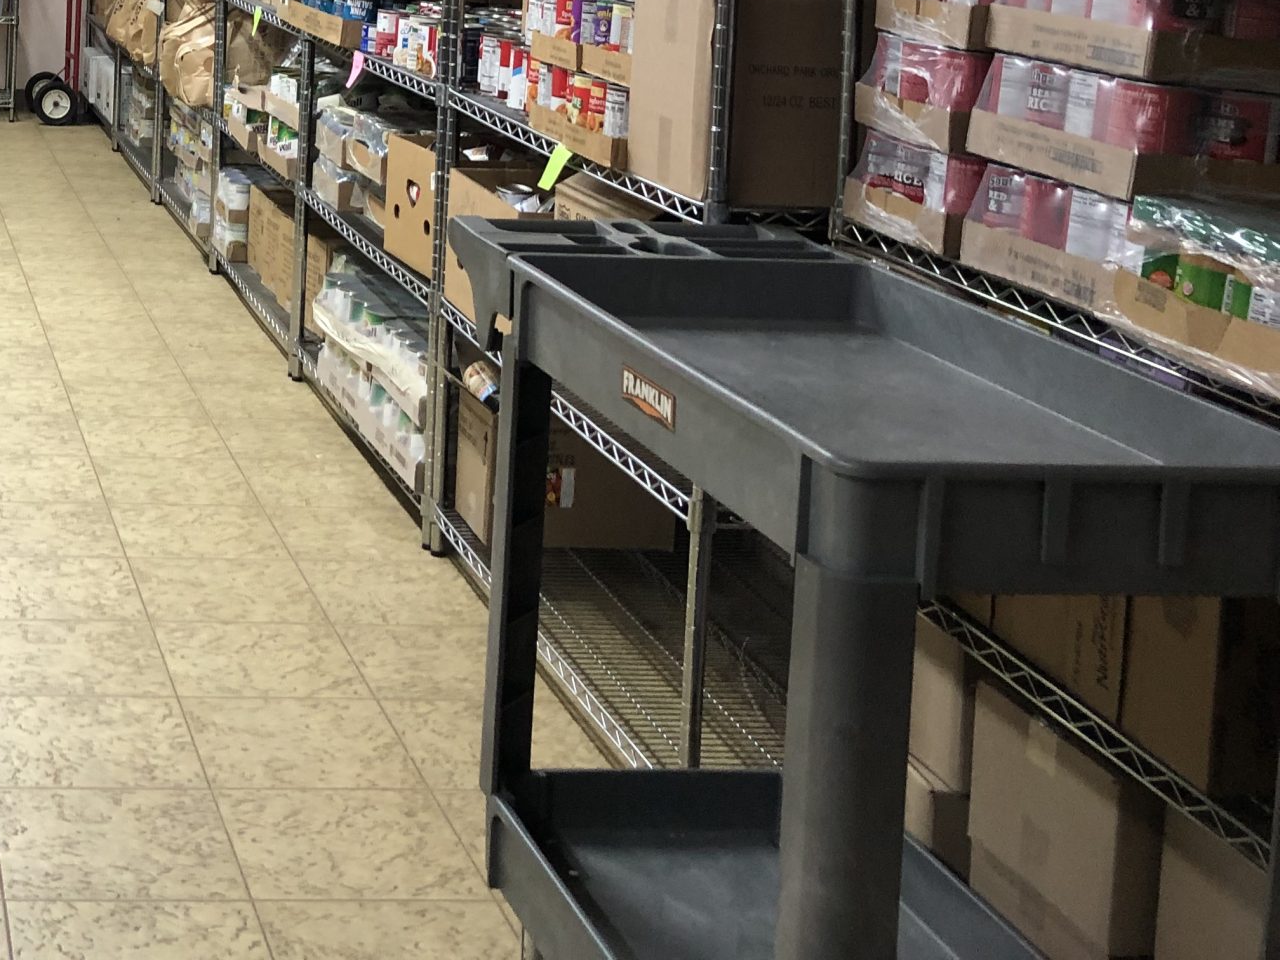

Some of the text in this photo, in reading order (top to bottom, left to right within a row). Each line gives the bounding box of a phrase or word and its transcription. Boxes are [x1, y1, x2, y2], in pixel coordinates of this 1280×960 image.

[748, 63, 790, 77] ORCHARD
[793, 64, 817, 78] PARK
[1027, 96, 1049, 111] RIC
[623, 370, 672, 424] FRANKLIN
